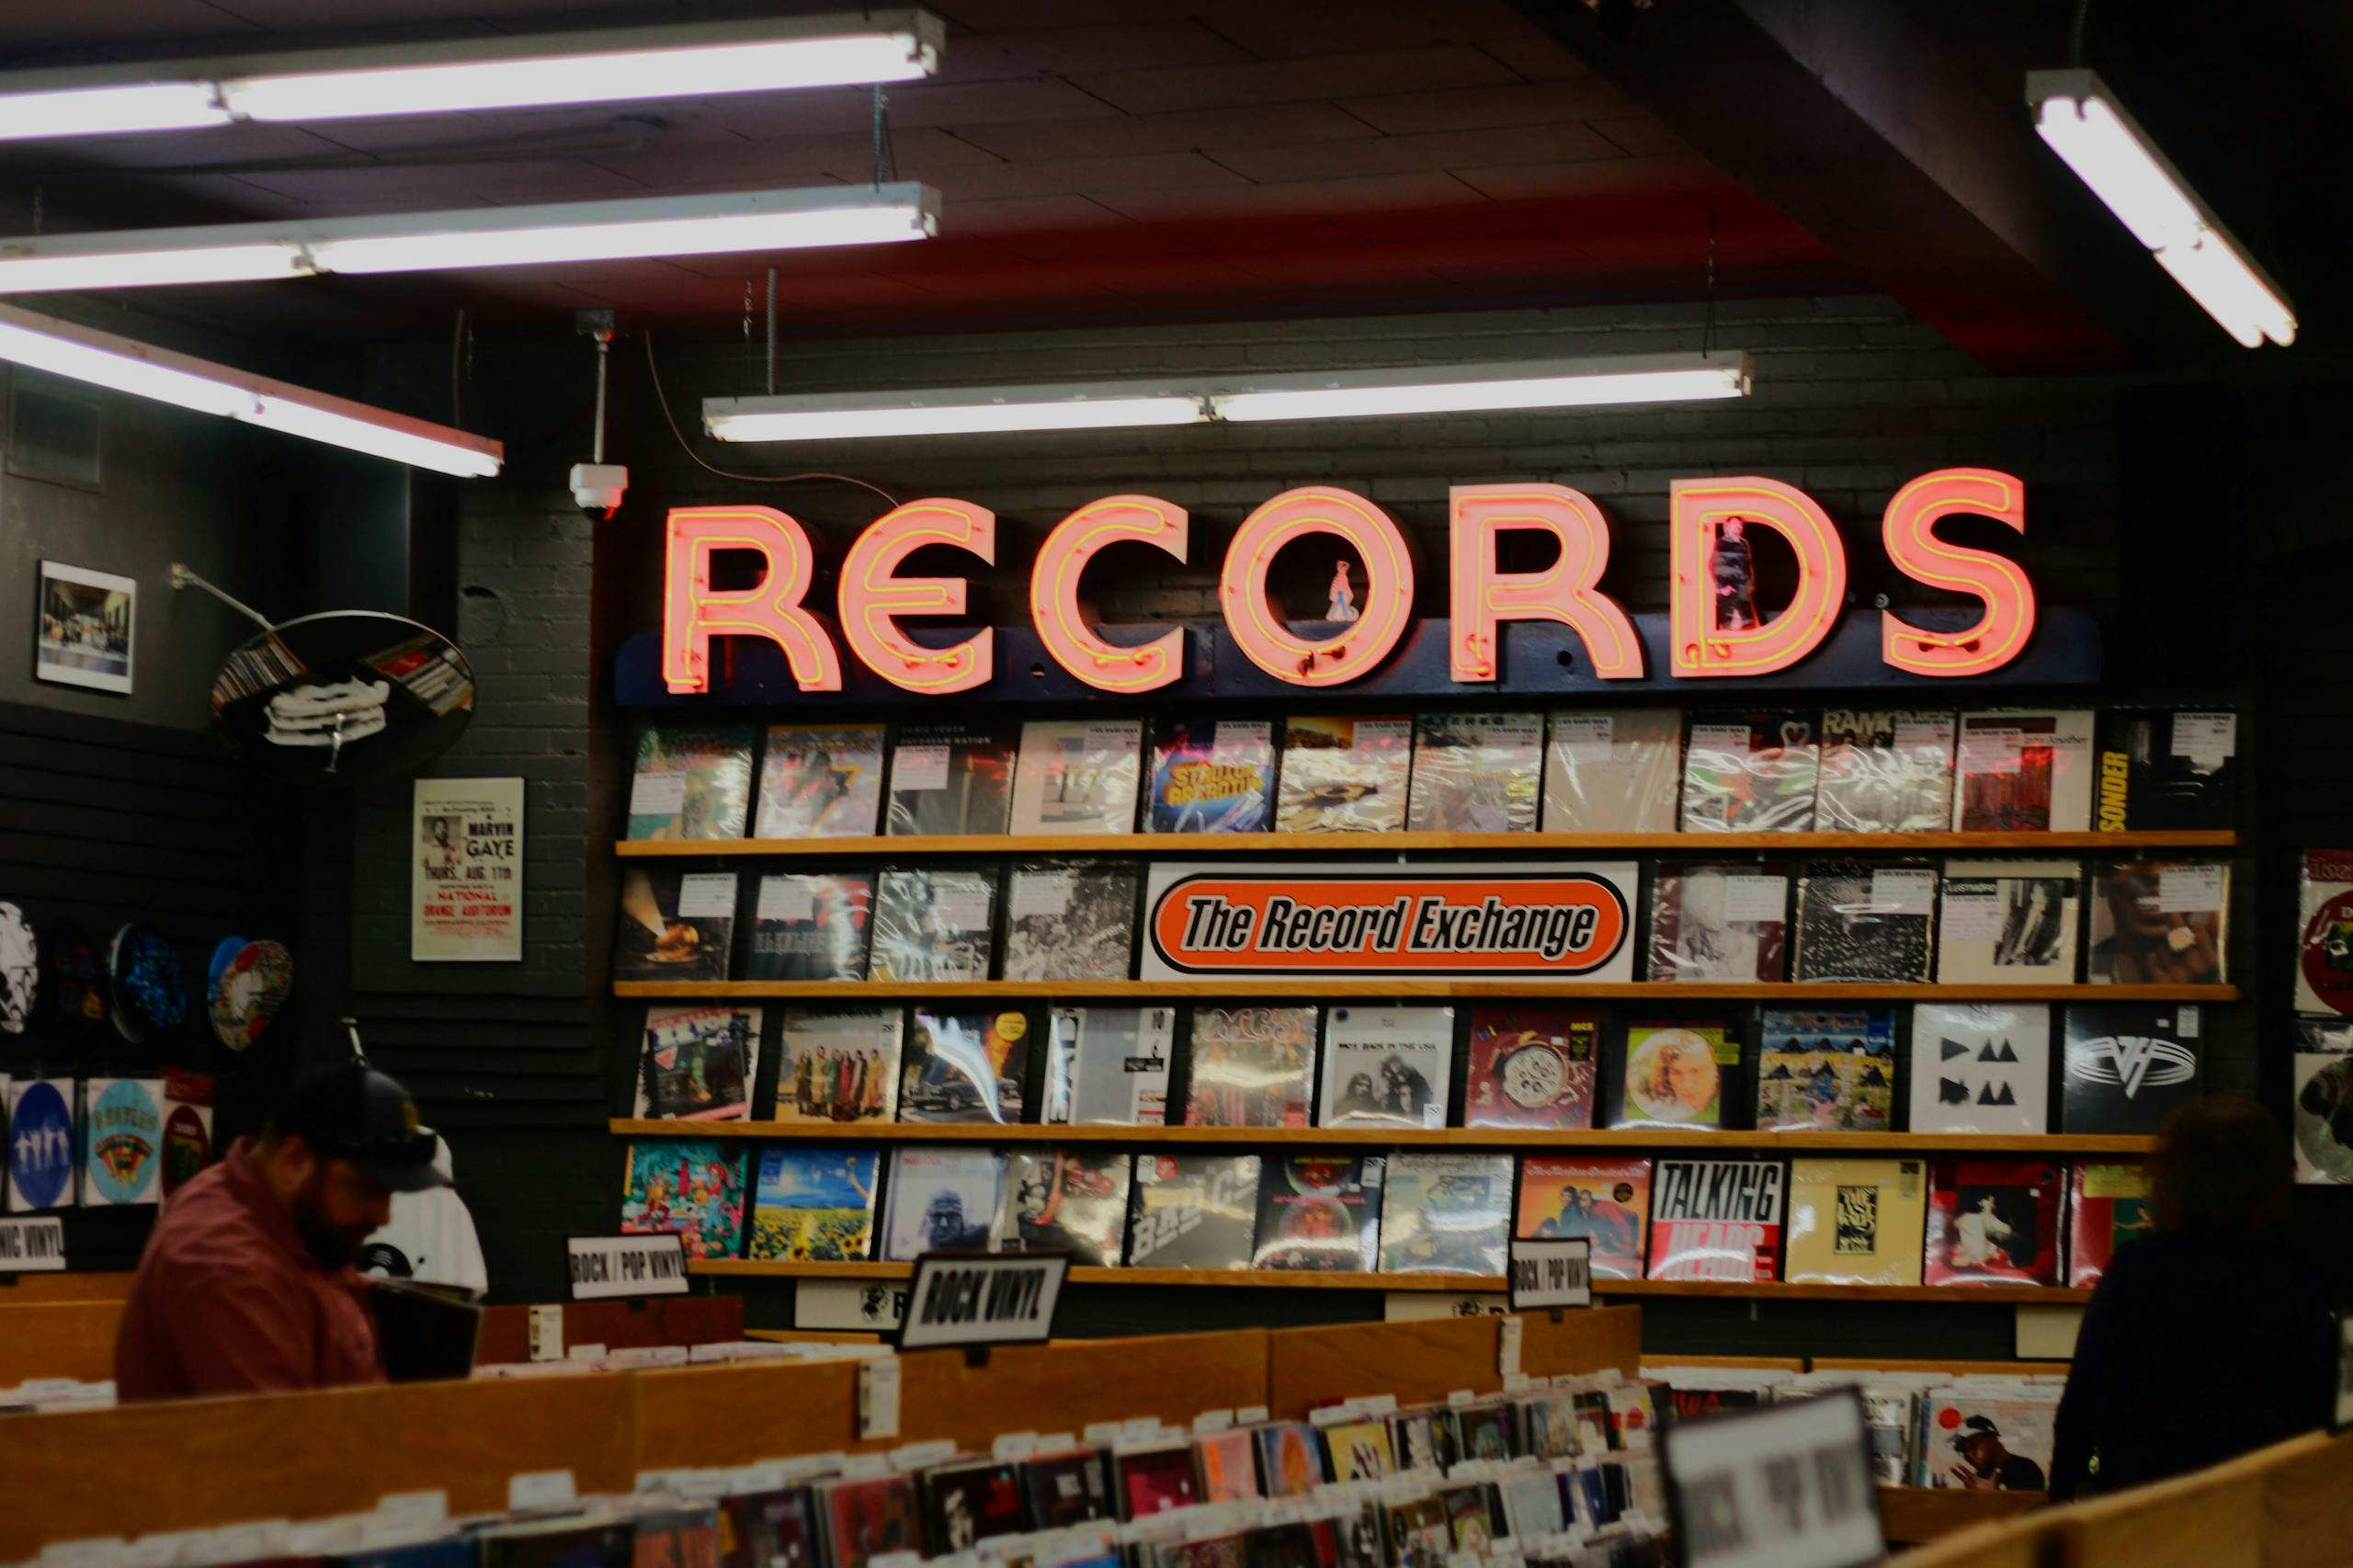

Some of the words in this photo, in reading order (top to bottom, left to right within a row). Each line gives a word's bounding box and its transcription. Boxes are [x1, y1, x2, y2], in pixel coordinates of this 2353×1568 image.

[666, 468, 2035, 694] RECORDS
[2097, 750, 2130, 832] SONDER
[465, 840, 515, 860] GAYE
[1184, 897, 1254, 949] The
[1257, 897, 1407, 949] Record
[1410, 897, 1597, 958] Exchange
[1660, 1163, 1779, 1221] TALKING
[23, 1224, 64, 1257] VINYL
[569, 1254, 608, 1284] ROCK
[620, 1251, 645, 1281] POP
[648, 1250, 687, 1279] VINYL
[1662, 1223, 1766, 1280] HEADS
[921, 1268, 988, 1325] ROCK
[984, 1267, 1046, 1322] VINYL
[1547, 1258, 1564, 1290] POP
